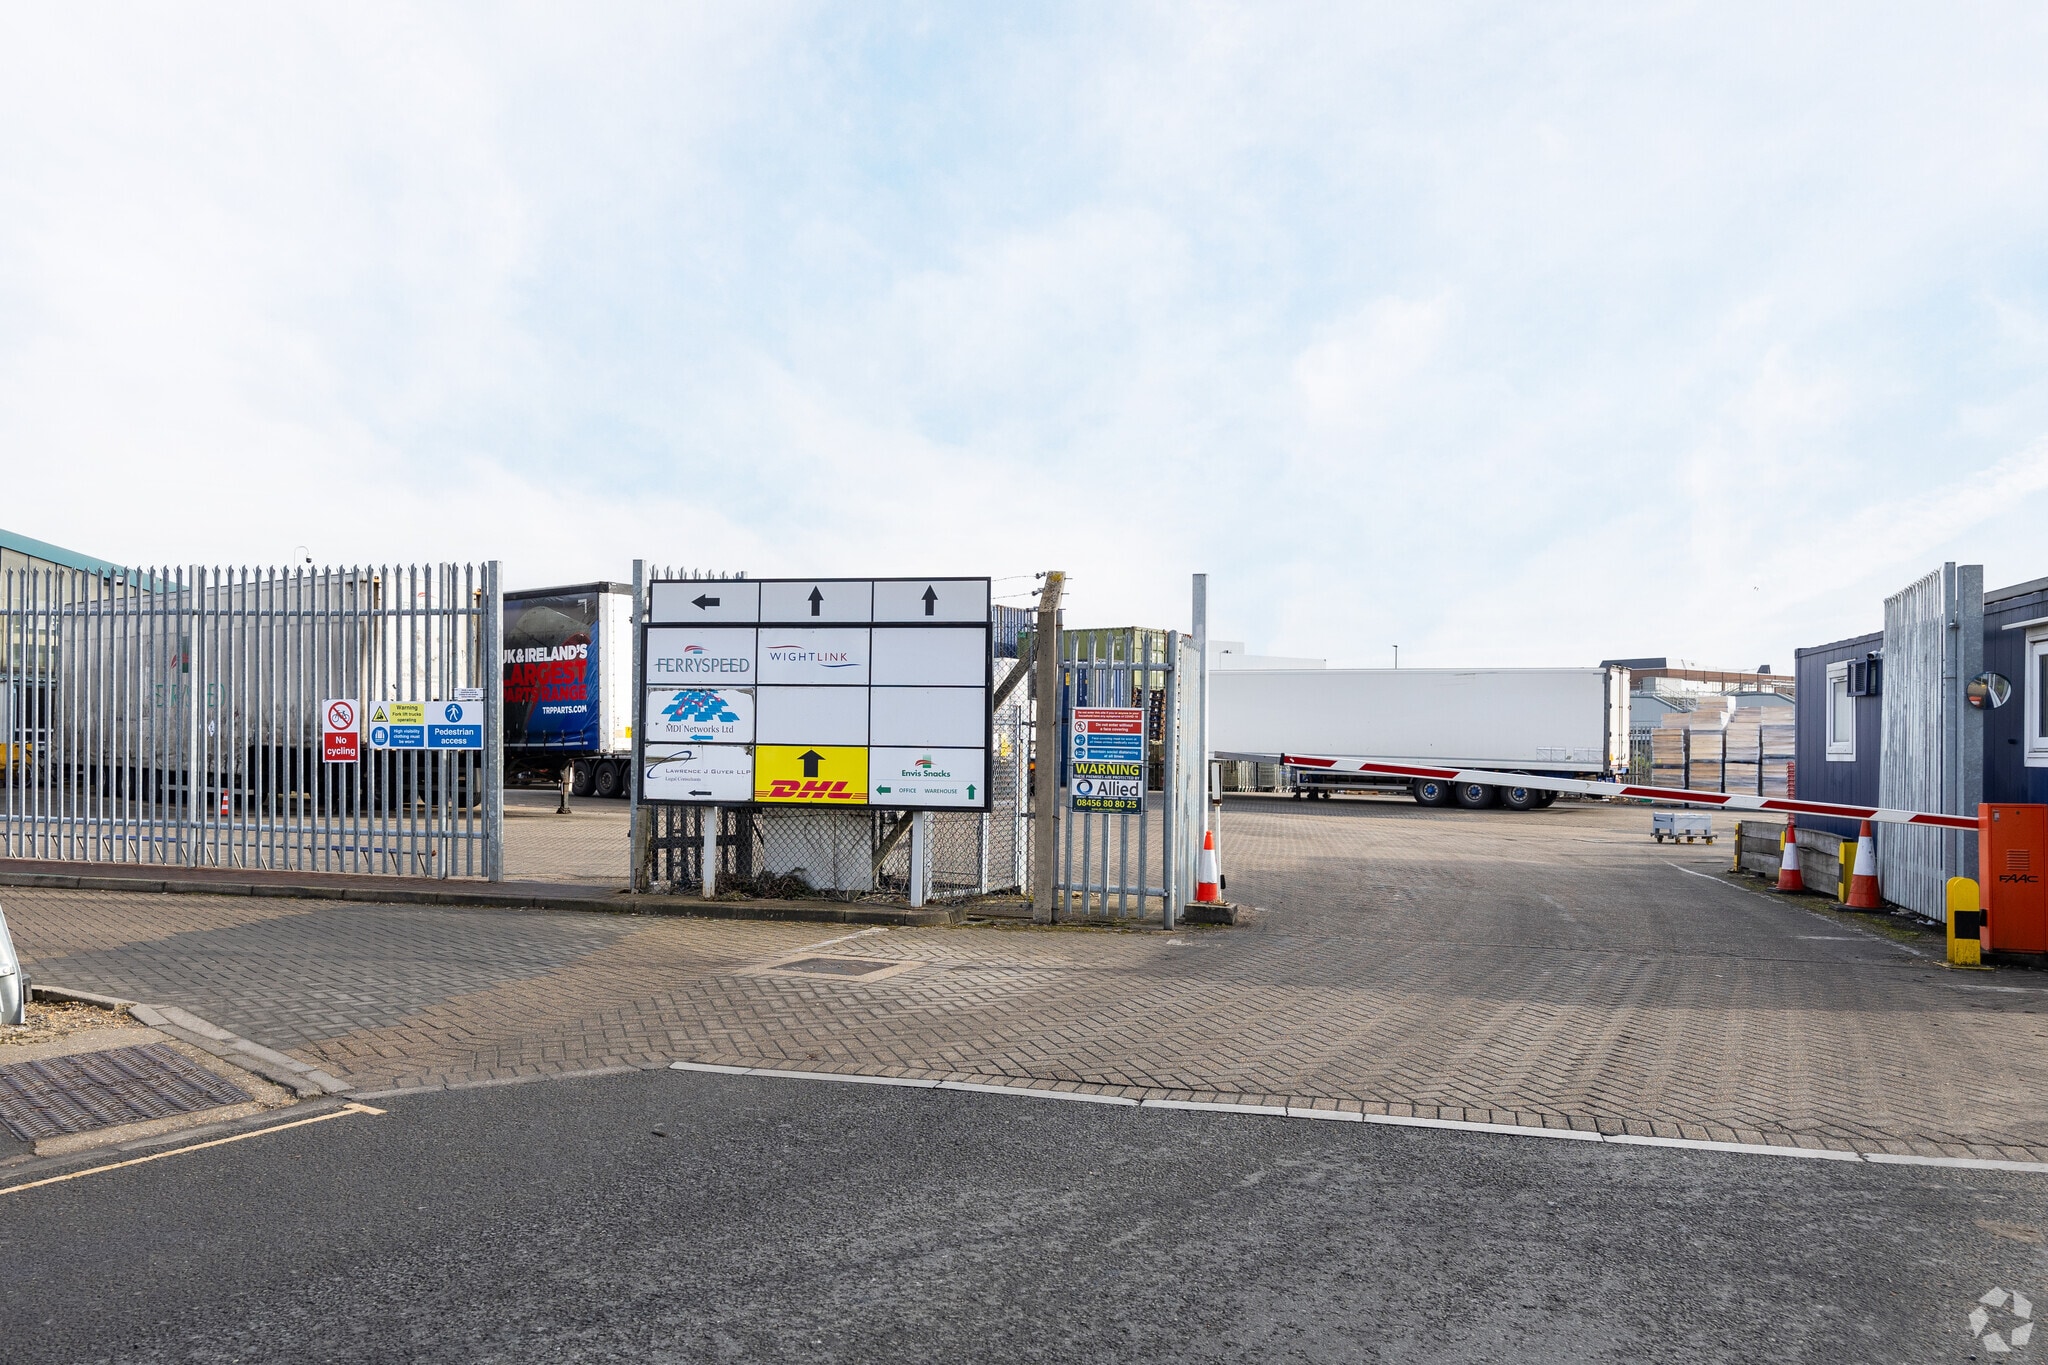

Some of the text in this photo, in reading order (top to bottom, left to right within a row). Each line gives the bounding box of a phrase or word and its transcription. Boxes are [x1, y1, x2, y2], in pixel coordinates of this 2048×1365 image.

[770, 652, 848, 662] WIGHTLINK
[655, 658, 750, 672] FERRYSPEED
[541, 684, 588, 702] RANGE
[542, 704, 588, 714] TRPPARTS.COM
[722, 726, 734, 734] Ltd
[335, 736, 347, 744] No
[327, 747, 356, 756] cycling
[1075, 763, 1139, 775] WARNING
[769, 780, 853, 799] DHL
[1097, 781, 1138, 796] Allied
[1999, 874, 2039, 883] FAAC
